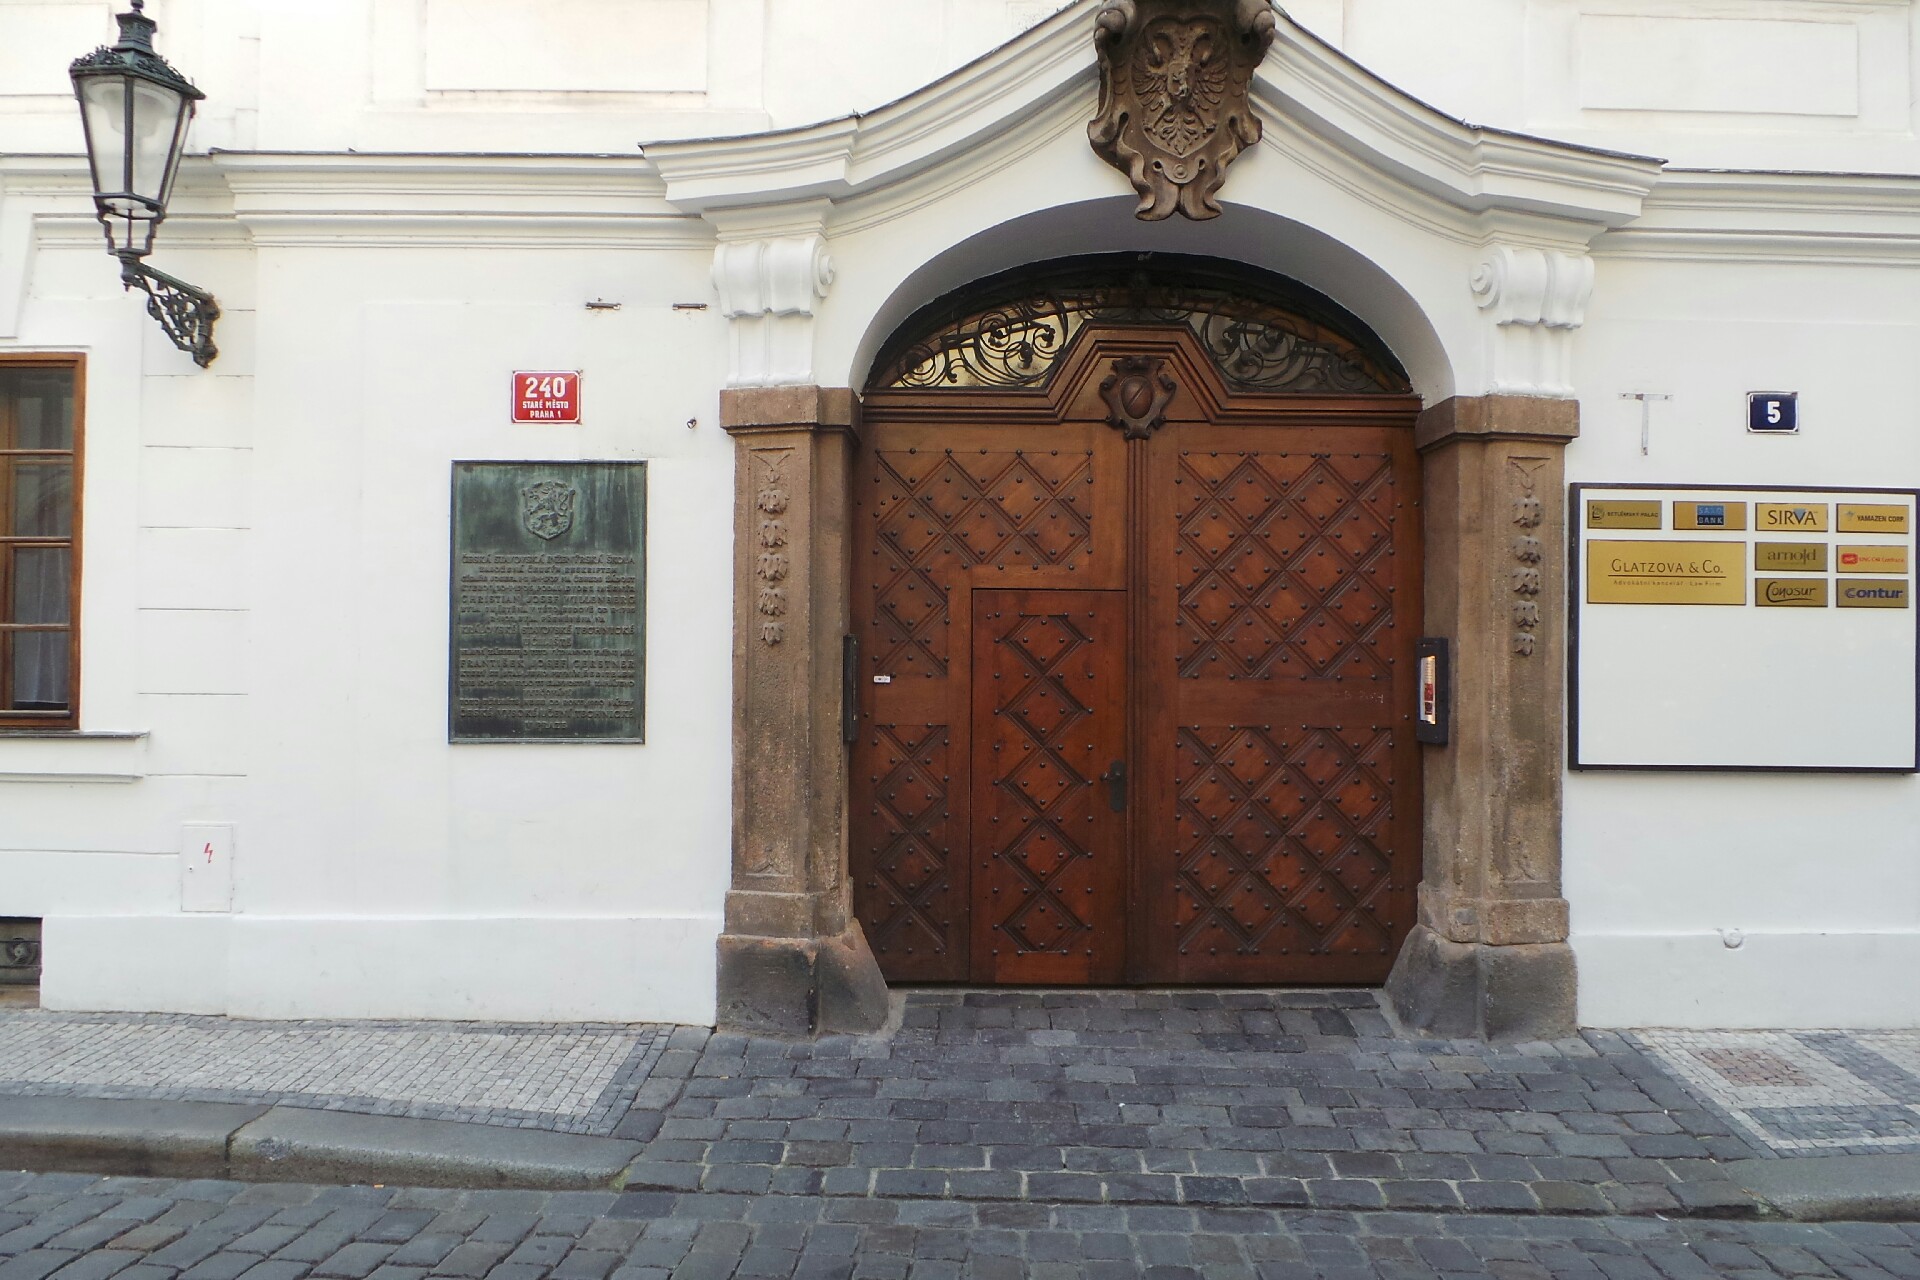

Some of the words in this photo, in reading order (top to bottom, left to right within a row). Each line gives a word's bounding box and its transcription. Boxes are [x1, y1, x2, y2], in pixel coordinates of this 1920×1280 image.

[525, 376, 566, 398] 240
[522, 399, 544, 409] STARÉ
[545, 399, 569, 409] MĚSTO
[529, 410, 555, 419] PRAHA
[557, 410, 562, 419] 1
[1767, 401, 1781, 424] 5
[1767, 509, 1817, 525] SIRVA
[1767, 548, 1817, 565] arnold
[1689, 562, 1699, 573] &
[526, 594, 560, 604] JOSEF
[563, 595, 636, 605] WILLENBERG
[573, 659, 635, 669] GERSTNER
